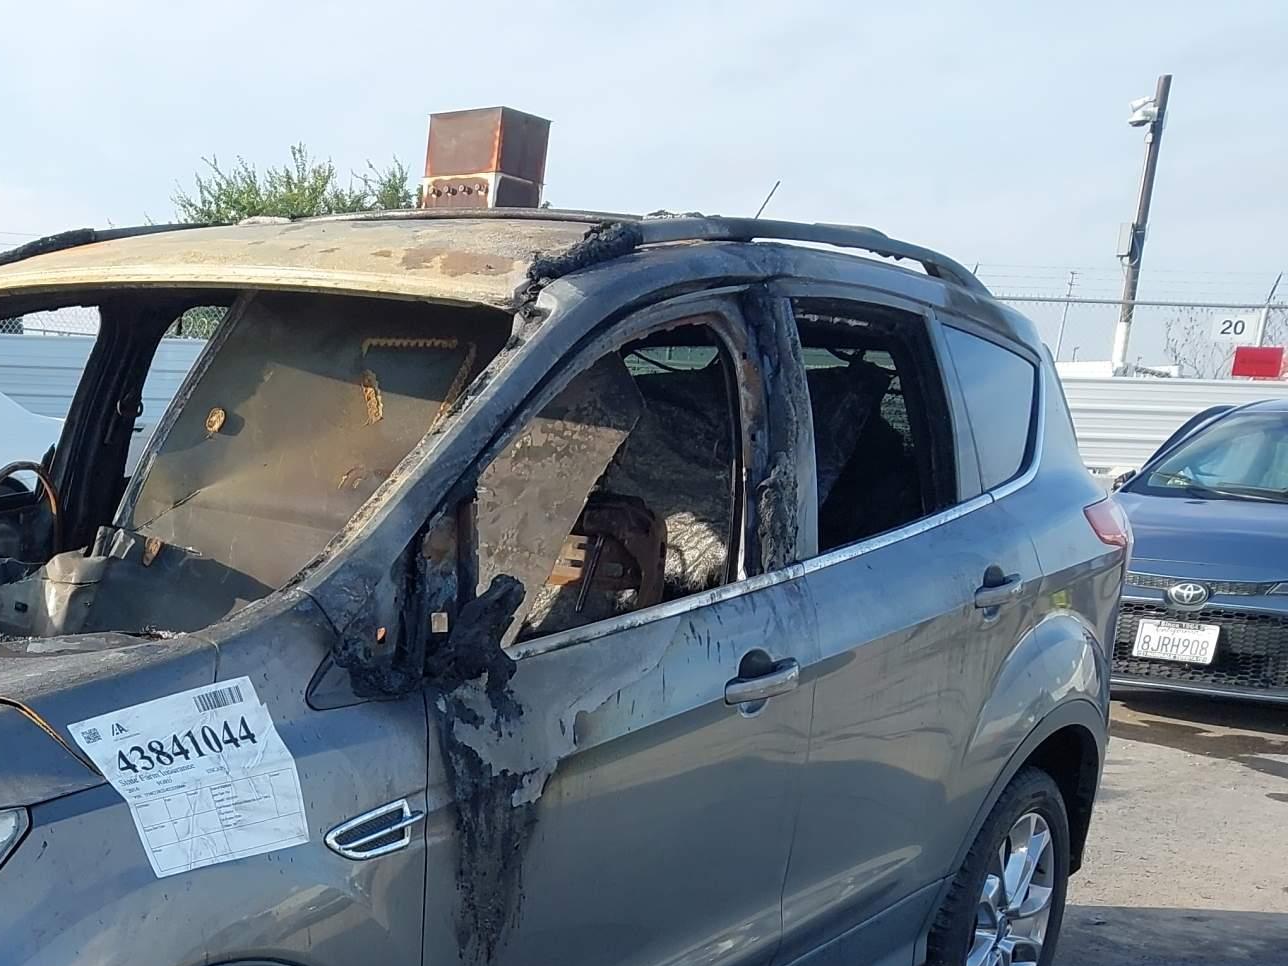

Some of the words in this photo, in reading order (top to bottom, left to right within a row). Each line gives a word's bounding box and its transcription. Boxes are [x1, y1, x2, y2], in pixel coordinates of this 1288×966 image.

[1220, 319, 1245, 335] 20
[1141, 634, 1209, 657] 8JRH908
[117, 715, 258, 774] 43841044
[118, 776, 139, 788] State
[139, 771, 160, 783] Farm
[159, 763, 196, 778] Insurance
